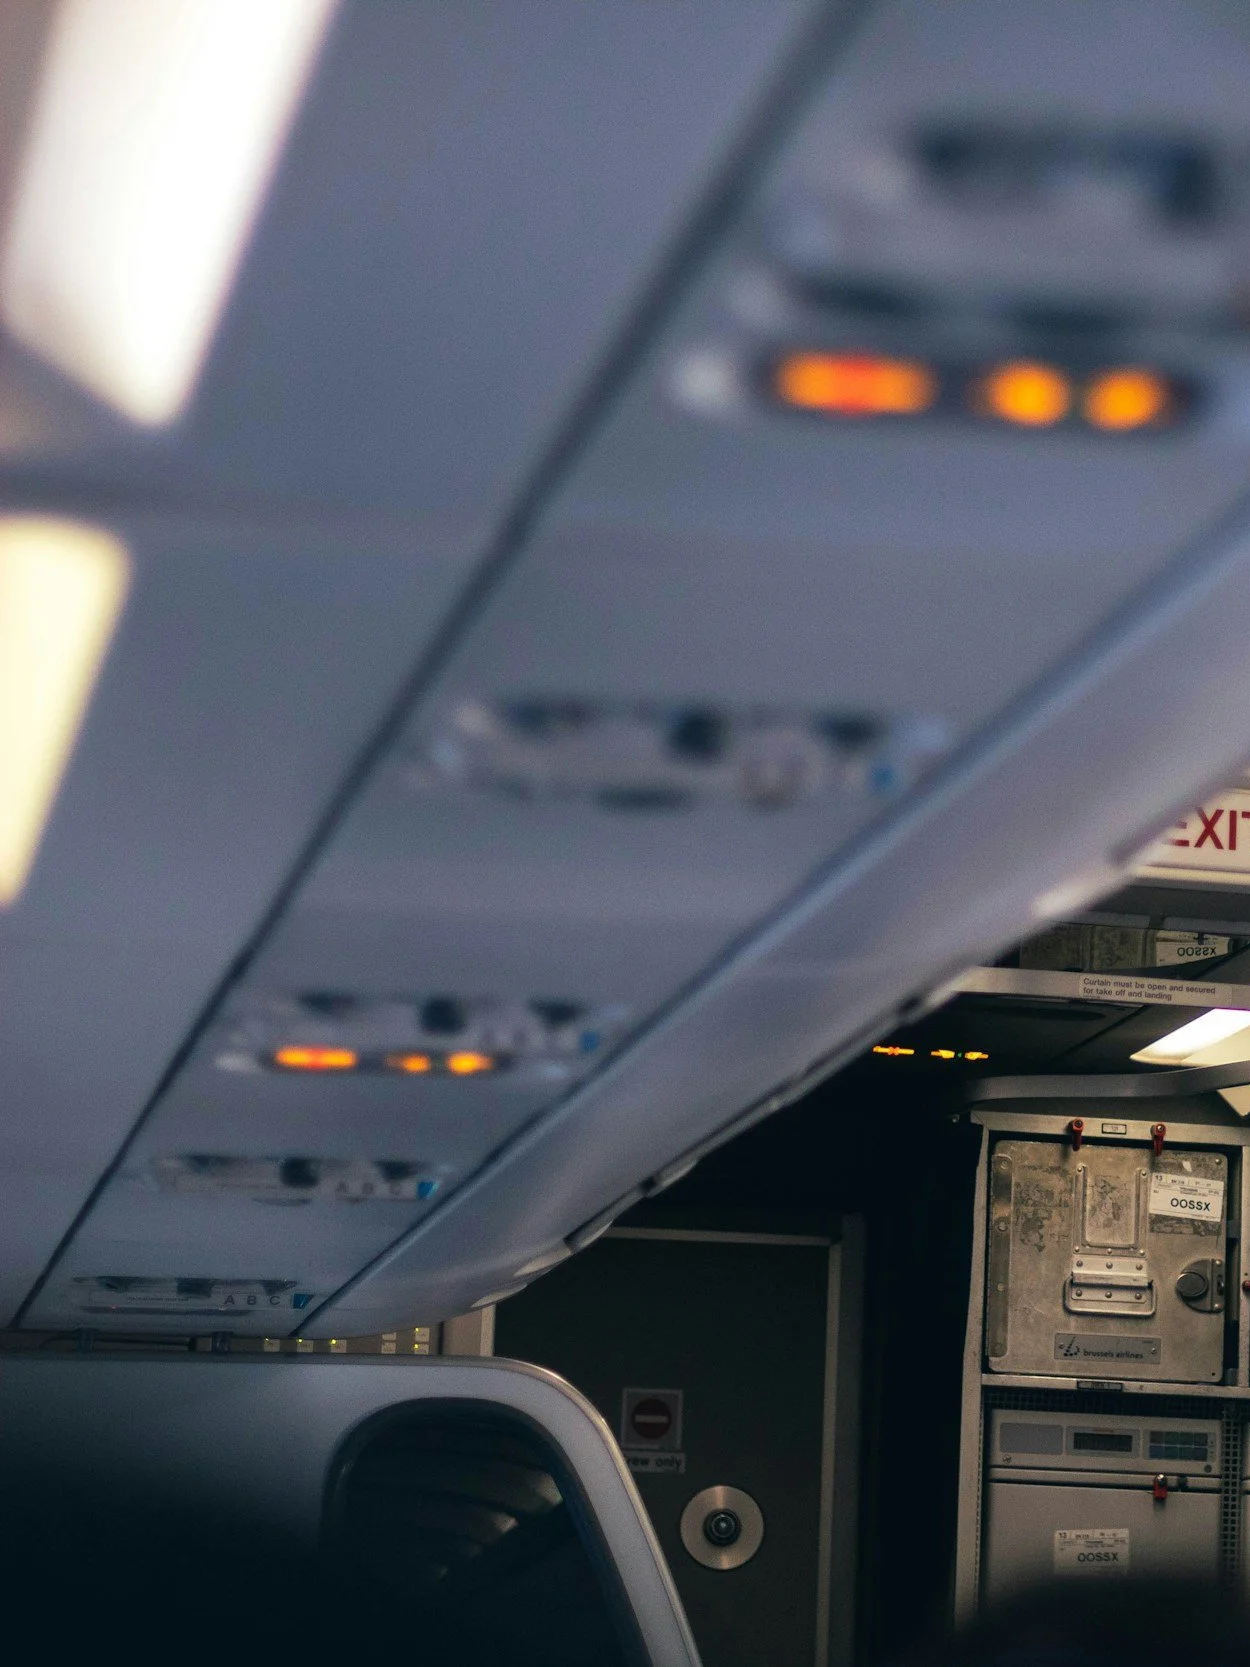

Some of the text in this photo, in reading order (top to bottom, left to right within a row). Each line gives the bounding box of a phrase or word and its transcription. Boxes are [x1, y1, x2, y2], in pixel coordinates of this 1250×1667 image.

[1083, 977, 1216, 994] Curtain must be open and secured
[1083, 986, 1172, 1001] for take off and landing
[1170, 1198, 1211, 1212] OOSSX
[224, 1295, 281, 1306] A B C
[1083, 1348, 1143, 1360] brussels airlines
[1078, 1552, 1119, 1562] OOSSX
